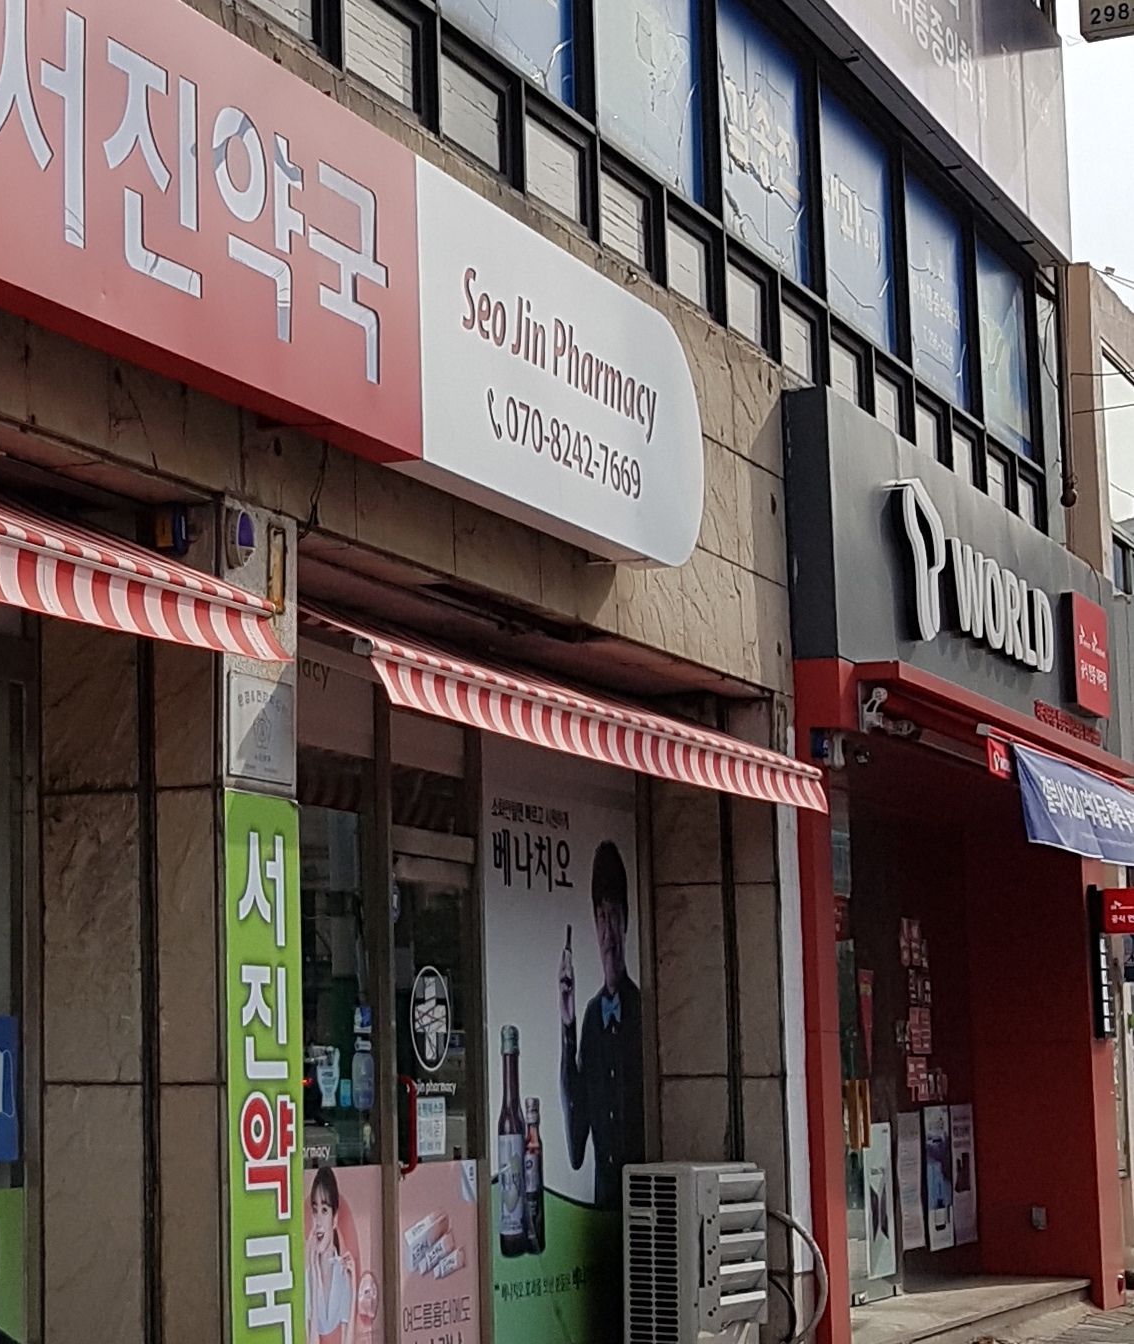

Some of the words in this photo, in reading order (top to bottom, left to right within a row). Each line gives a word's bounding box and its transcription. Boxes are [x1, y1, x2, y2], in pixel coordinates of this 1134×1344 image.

[1090, 2, 1134, 25] 298
[462, 267, 506, 348] Seo
[511, 296, 546, 370] Jin
[553, 318, 657, 445] Pharmacy
[506, 396, 641, 500] 070-8242-7669
[949, 537, 1054, 673] WORLD
[491, 828, 574, 893] 베나치오
[425, 1078, 457, 1096] pharmacy
[402, 1295, 471, 1334] 여드름흉터에도
